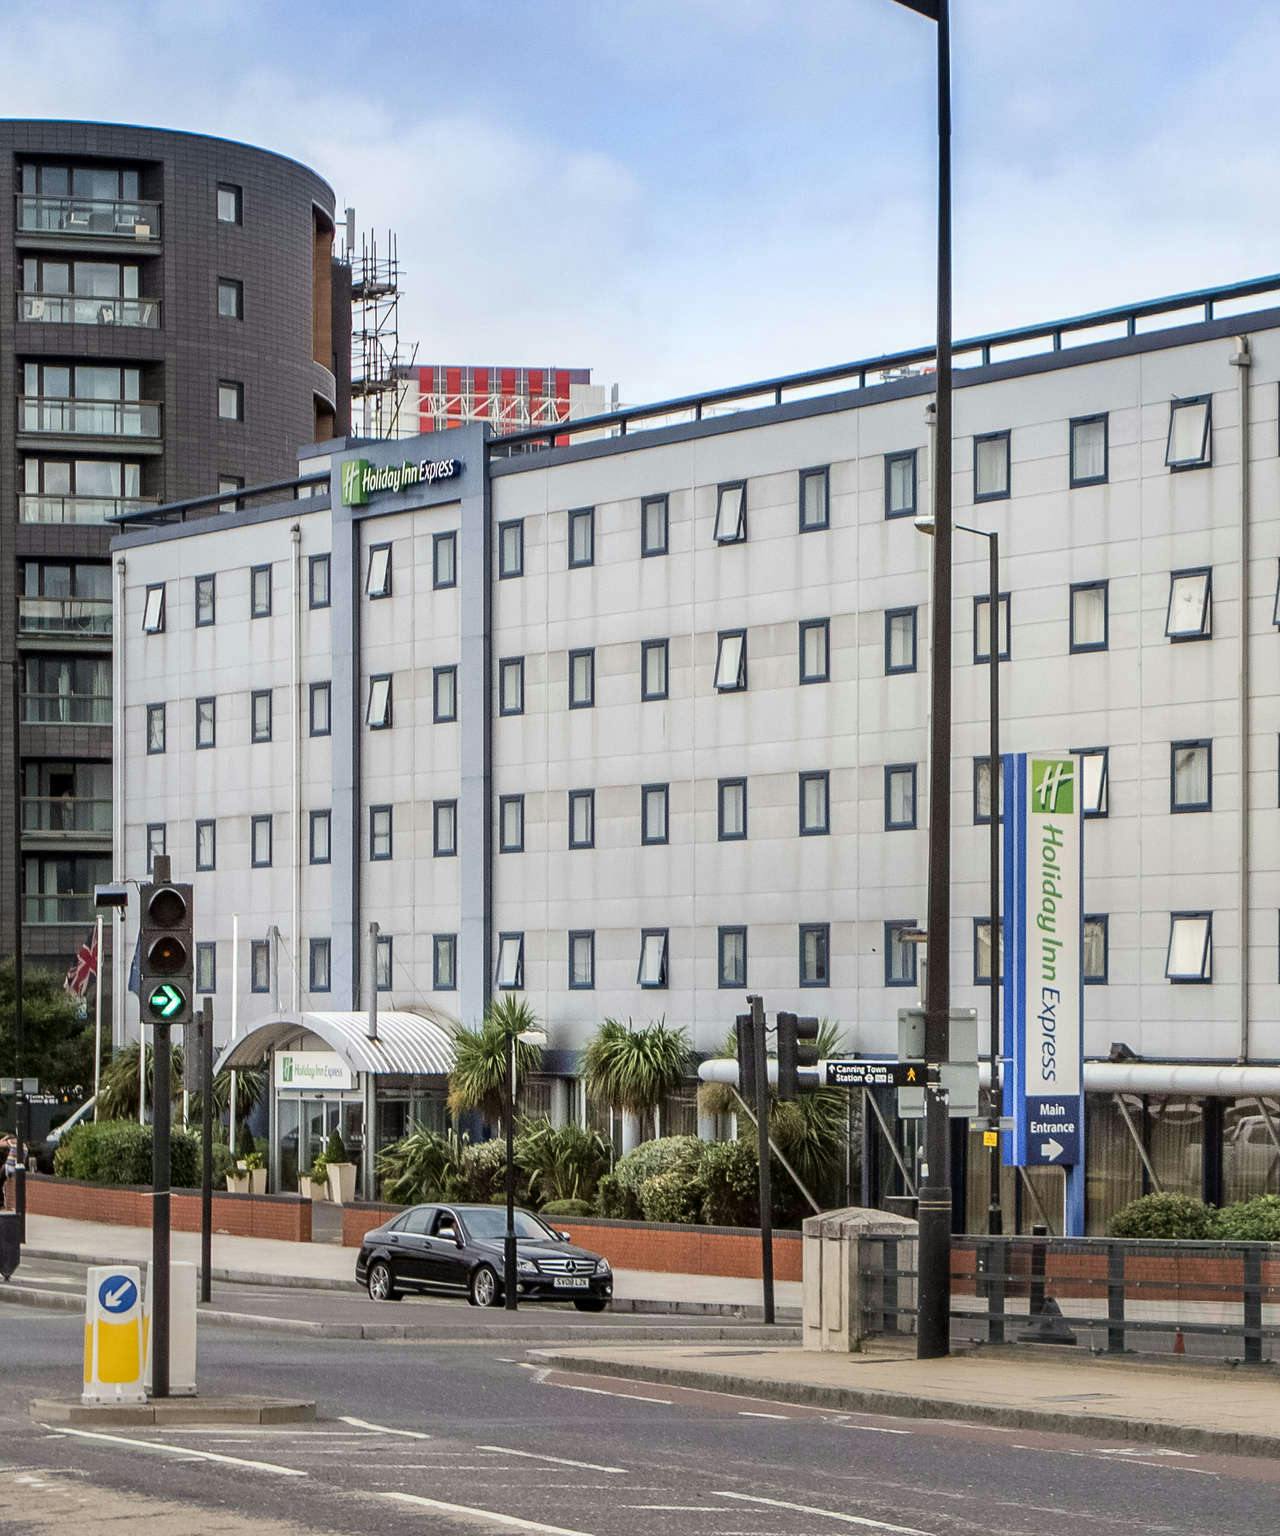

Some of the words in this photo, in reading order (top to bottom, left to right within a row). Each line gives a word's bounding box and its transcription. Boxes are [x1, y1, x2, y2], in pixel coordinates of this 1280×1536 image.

[362, 465, 401, 493] Holiday
[401, 460, 418, 485] Inn
[419, 459, 454, 485] Express
[1036, 823, 1064, 933] Holiday
[1042, 937, 1063, 982] Inn
[1037, 986, 1061, 1082] Express
[294, 1063, 316, 1080] Holiday
[325, 1065, 343, 1079] Express
[836, 1065, 865, 1075] Canning
[866, 1065, 887, 1073] Town
[836, 1074, 862, 1082] Station
[1039, 1104, 1065, 1116] Main
[1030, 1121, 1075, 1133] Entrance
